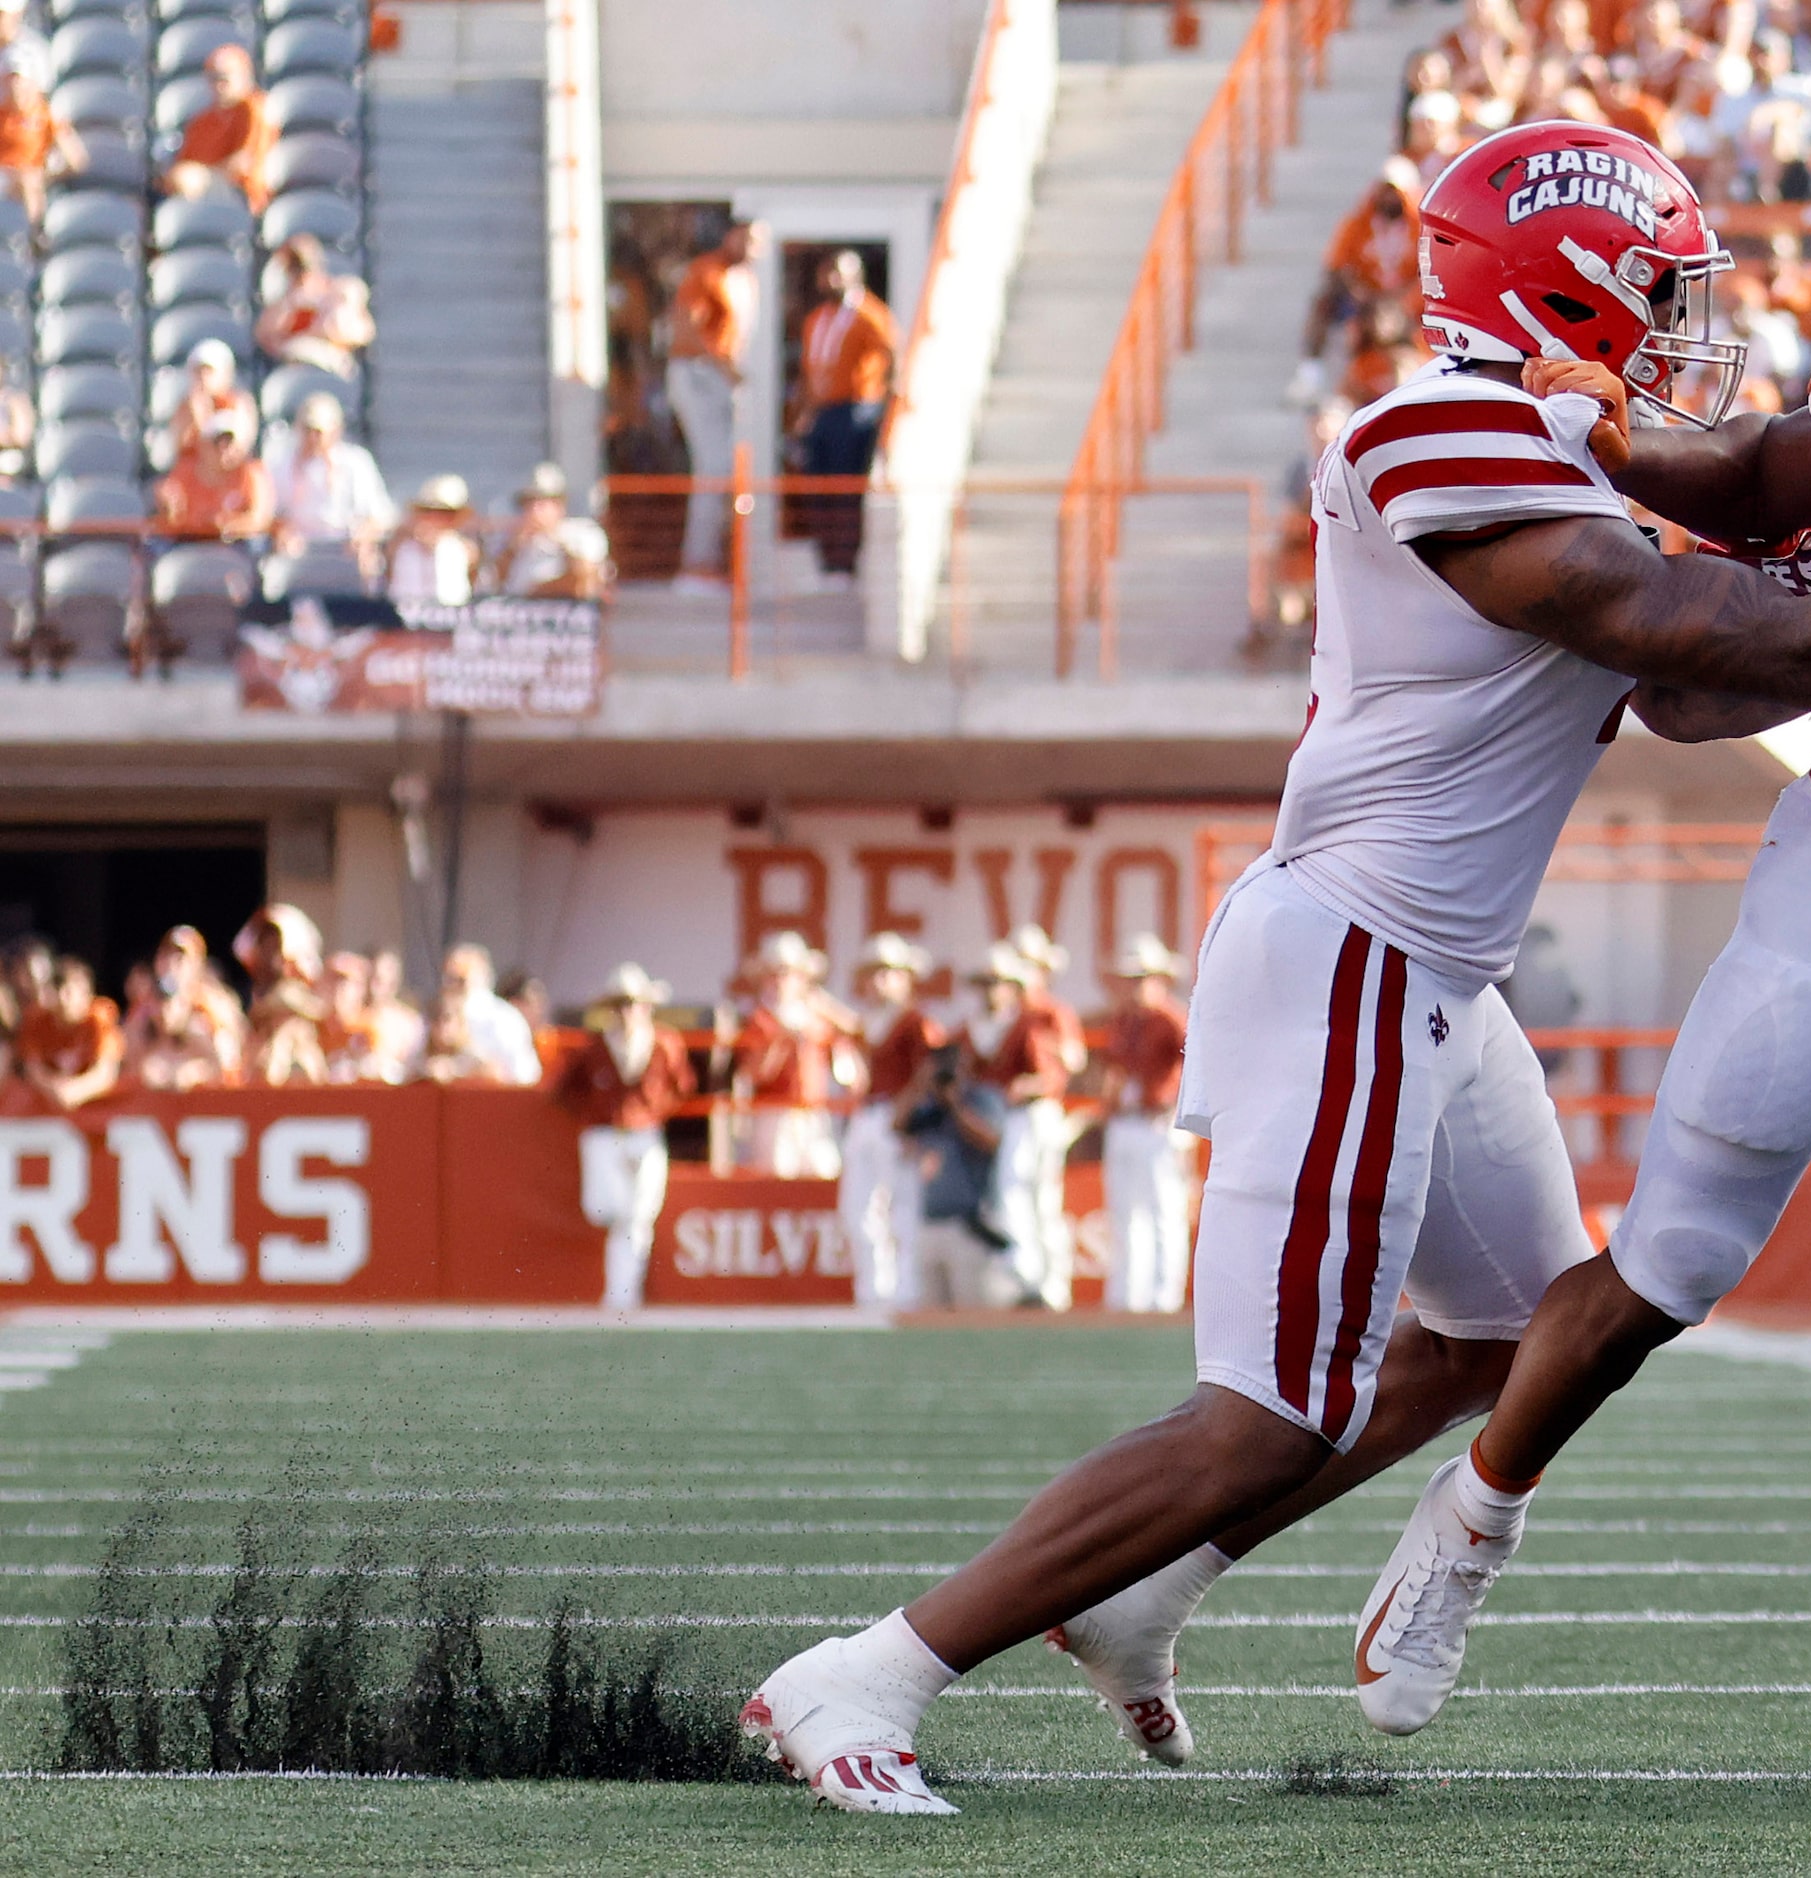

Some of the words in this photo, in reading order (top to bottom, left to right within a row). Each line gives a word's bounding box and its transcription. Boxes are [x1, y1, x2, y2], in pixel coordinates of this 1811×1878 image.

[1507, 177, 1656, 244] CAJUNS
[0, 1115, 372, 1285] RNS
[673, 1208, 854, 1277] SILVE
